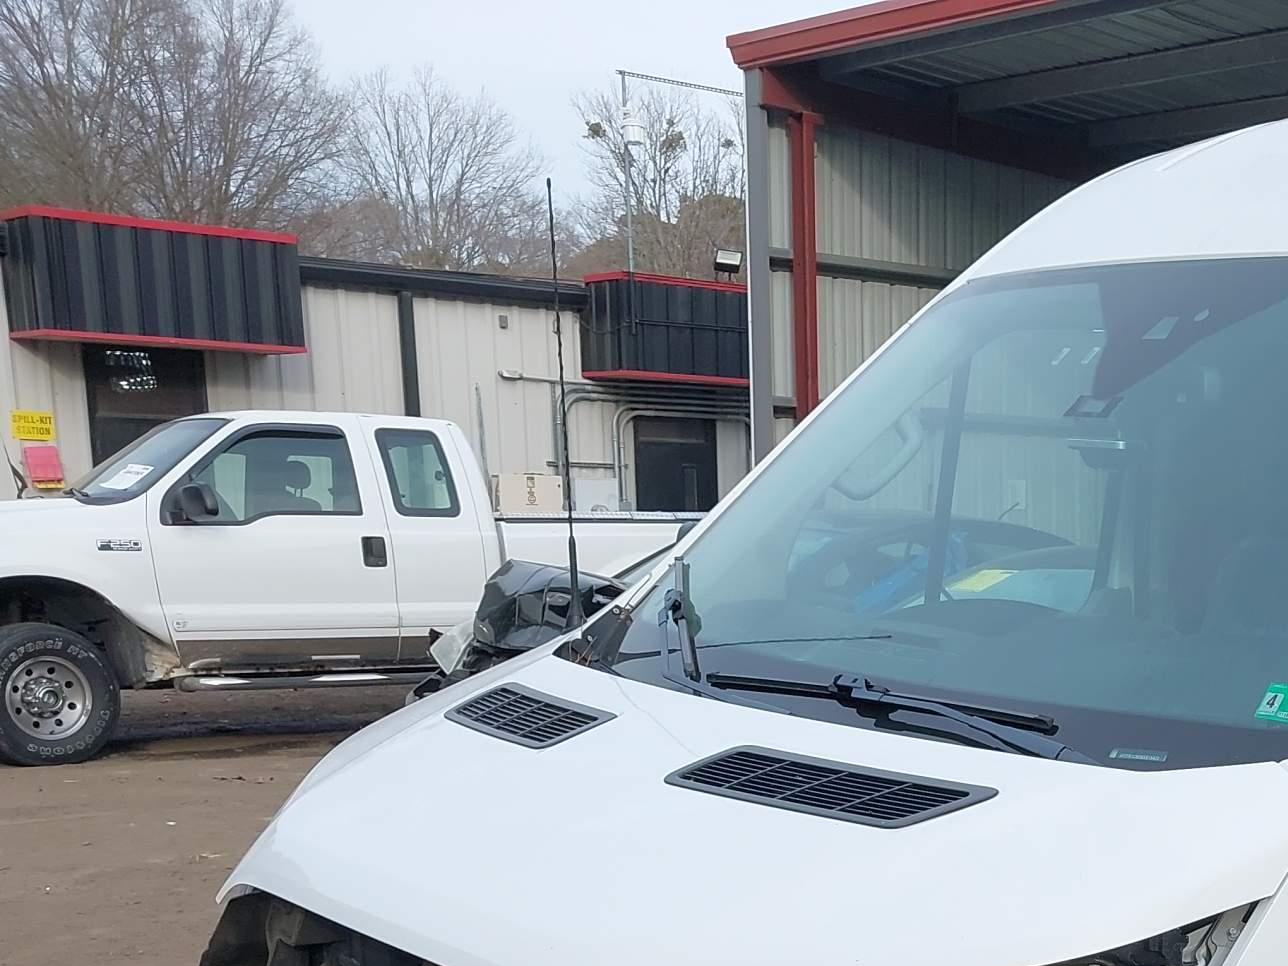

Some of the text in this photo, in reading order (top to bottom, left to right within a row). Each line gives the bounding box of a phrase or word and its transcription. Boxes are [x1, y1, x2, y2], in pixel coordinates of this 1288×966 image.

[12, 414, 52, 425] SPILL-KIT
[16, 425, 51, 436] STATION
[1265, 694, 1279, 709] 4
